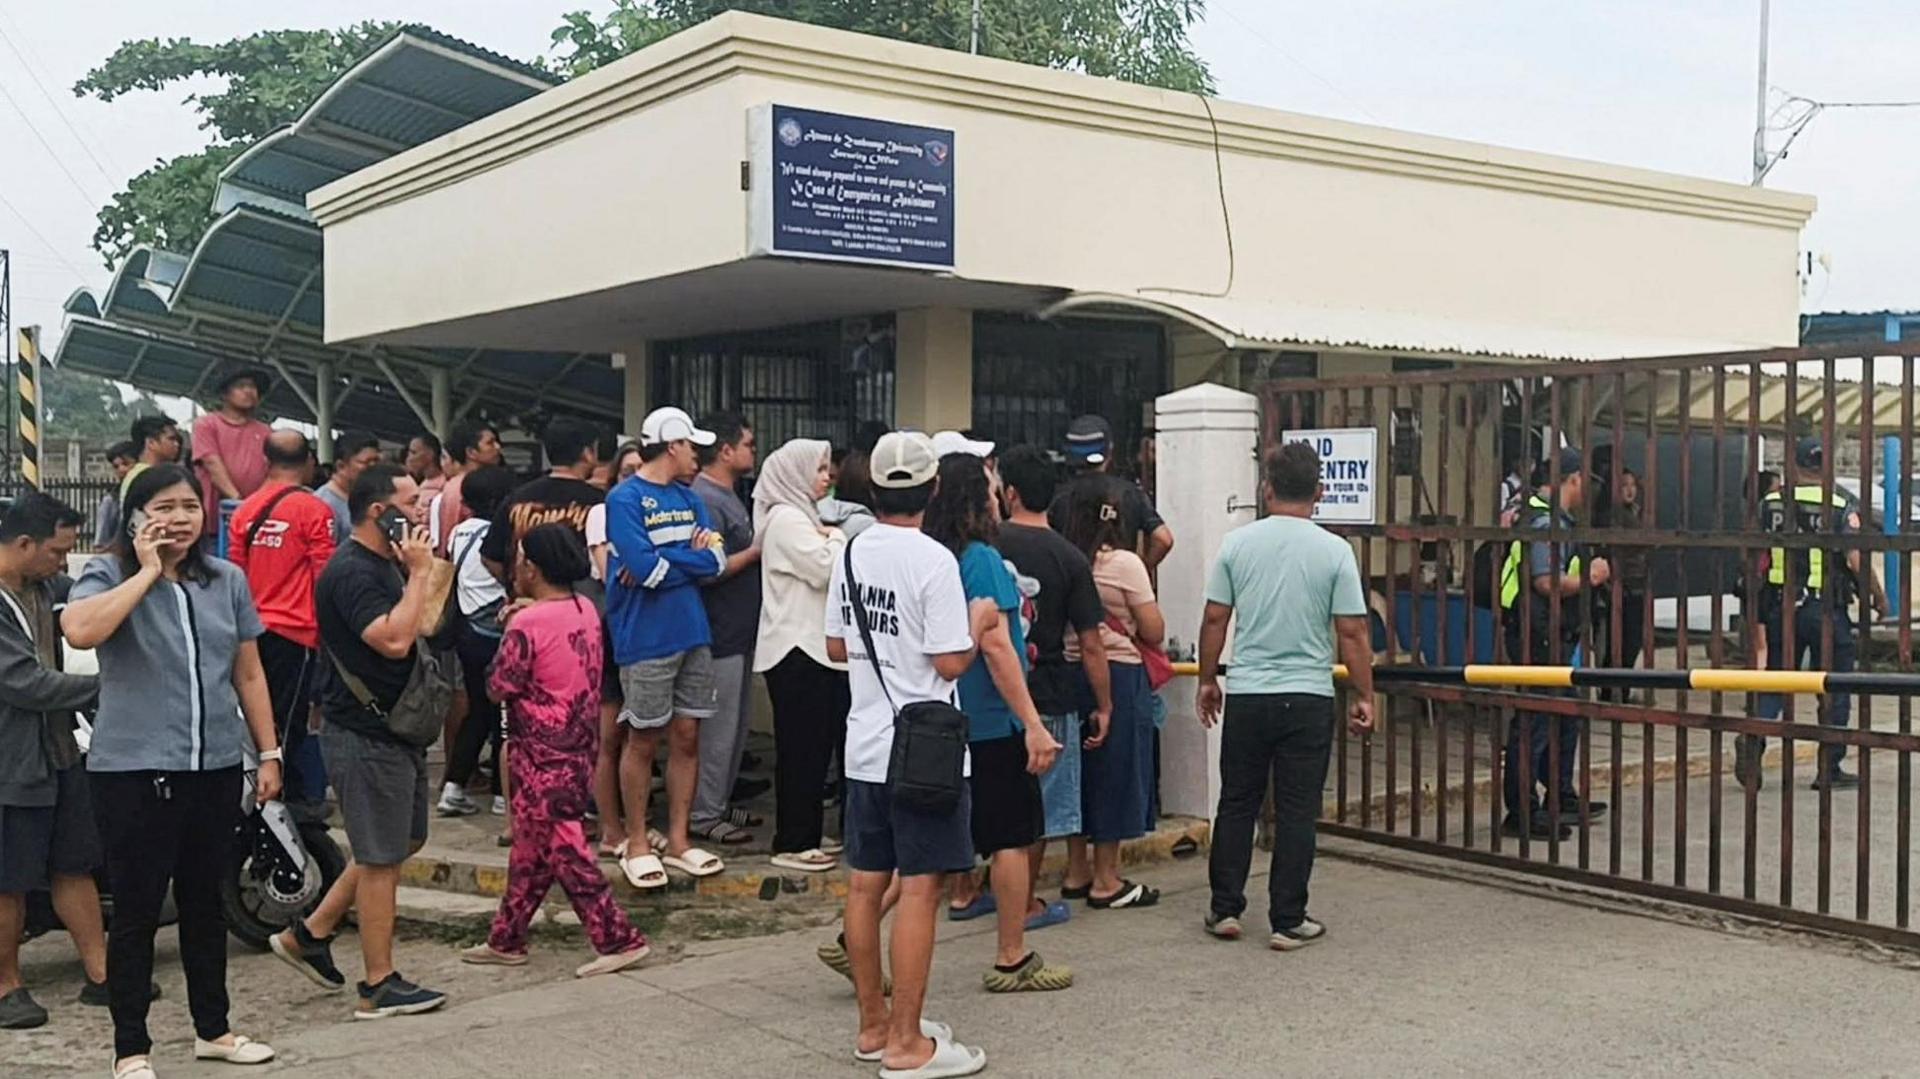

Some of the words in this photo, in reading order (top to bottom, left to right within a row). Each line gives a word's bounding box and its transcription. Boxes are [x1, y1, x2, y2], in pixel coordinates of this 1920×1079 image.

[829, 148, 867, 163] Security
[869, 154, 899, 165] Office
[805, 181, 825, 198] Case
[1316, 438, 1332, 456] ID
[1333, 483, 1354, 492] YOUR
[1341, 494, 1359, 504] THIS
[868, 611, 899, 637] URS
